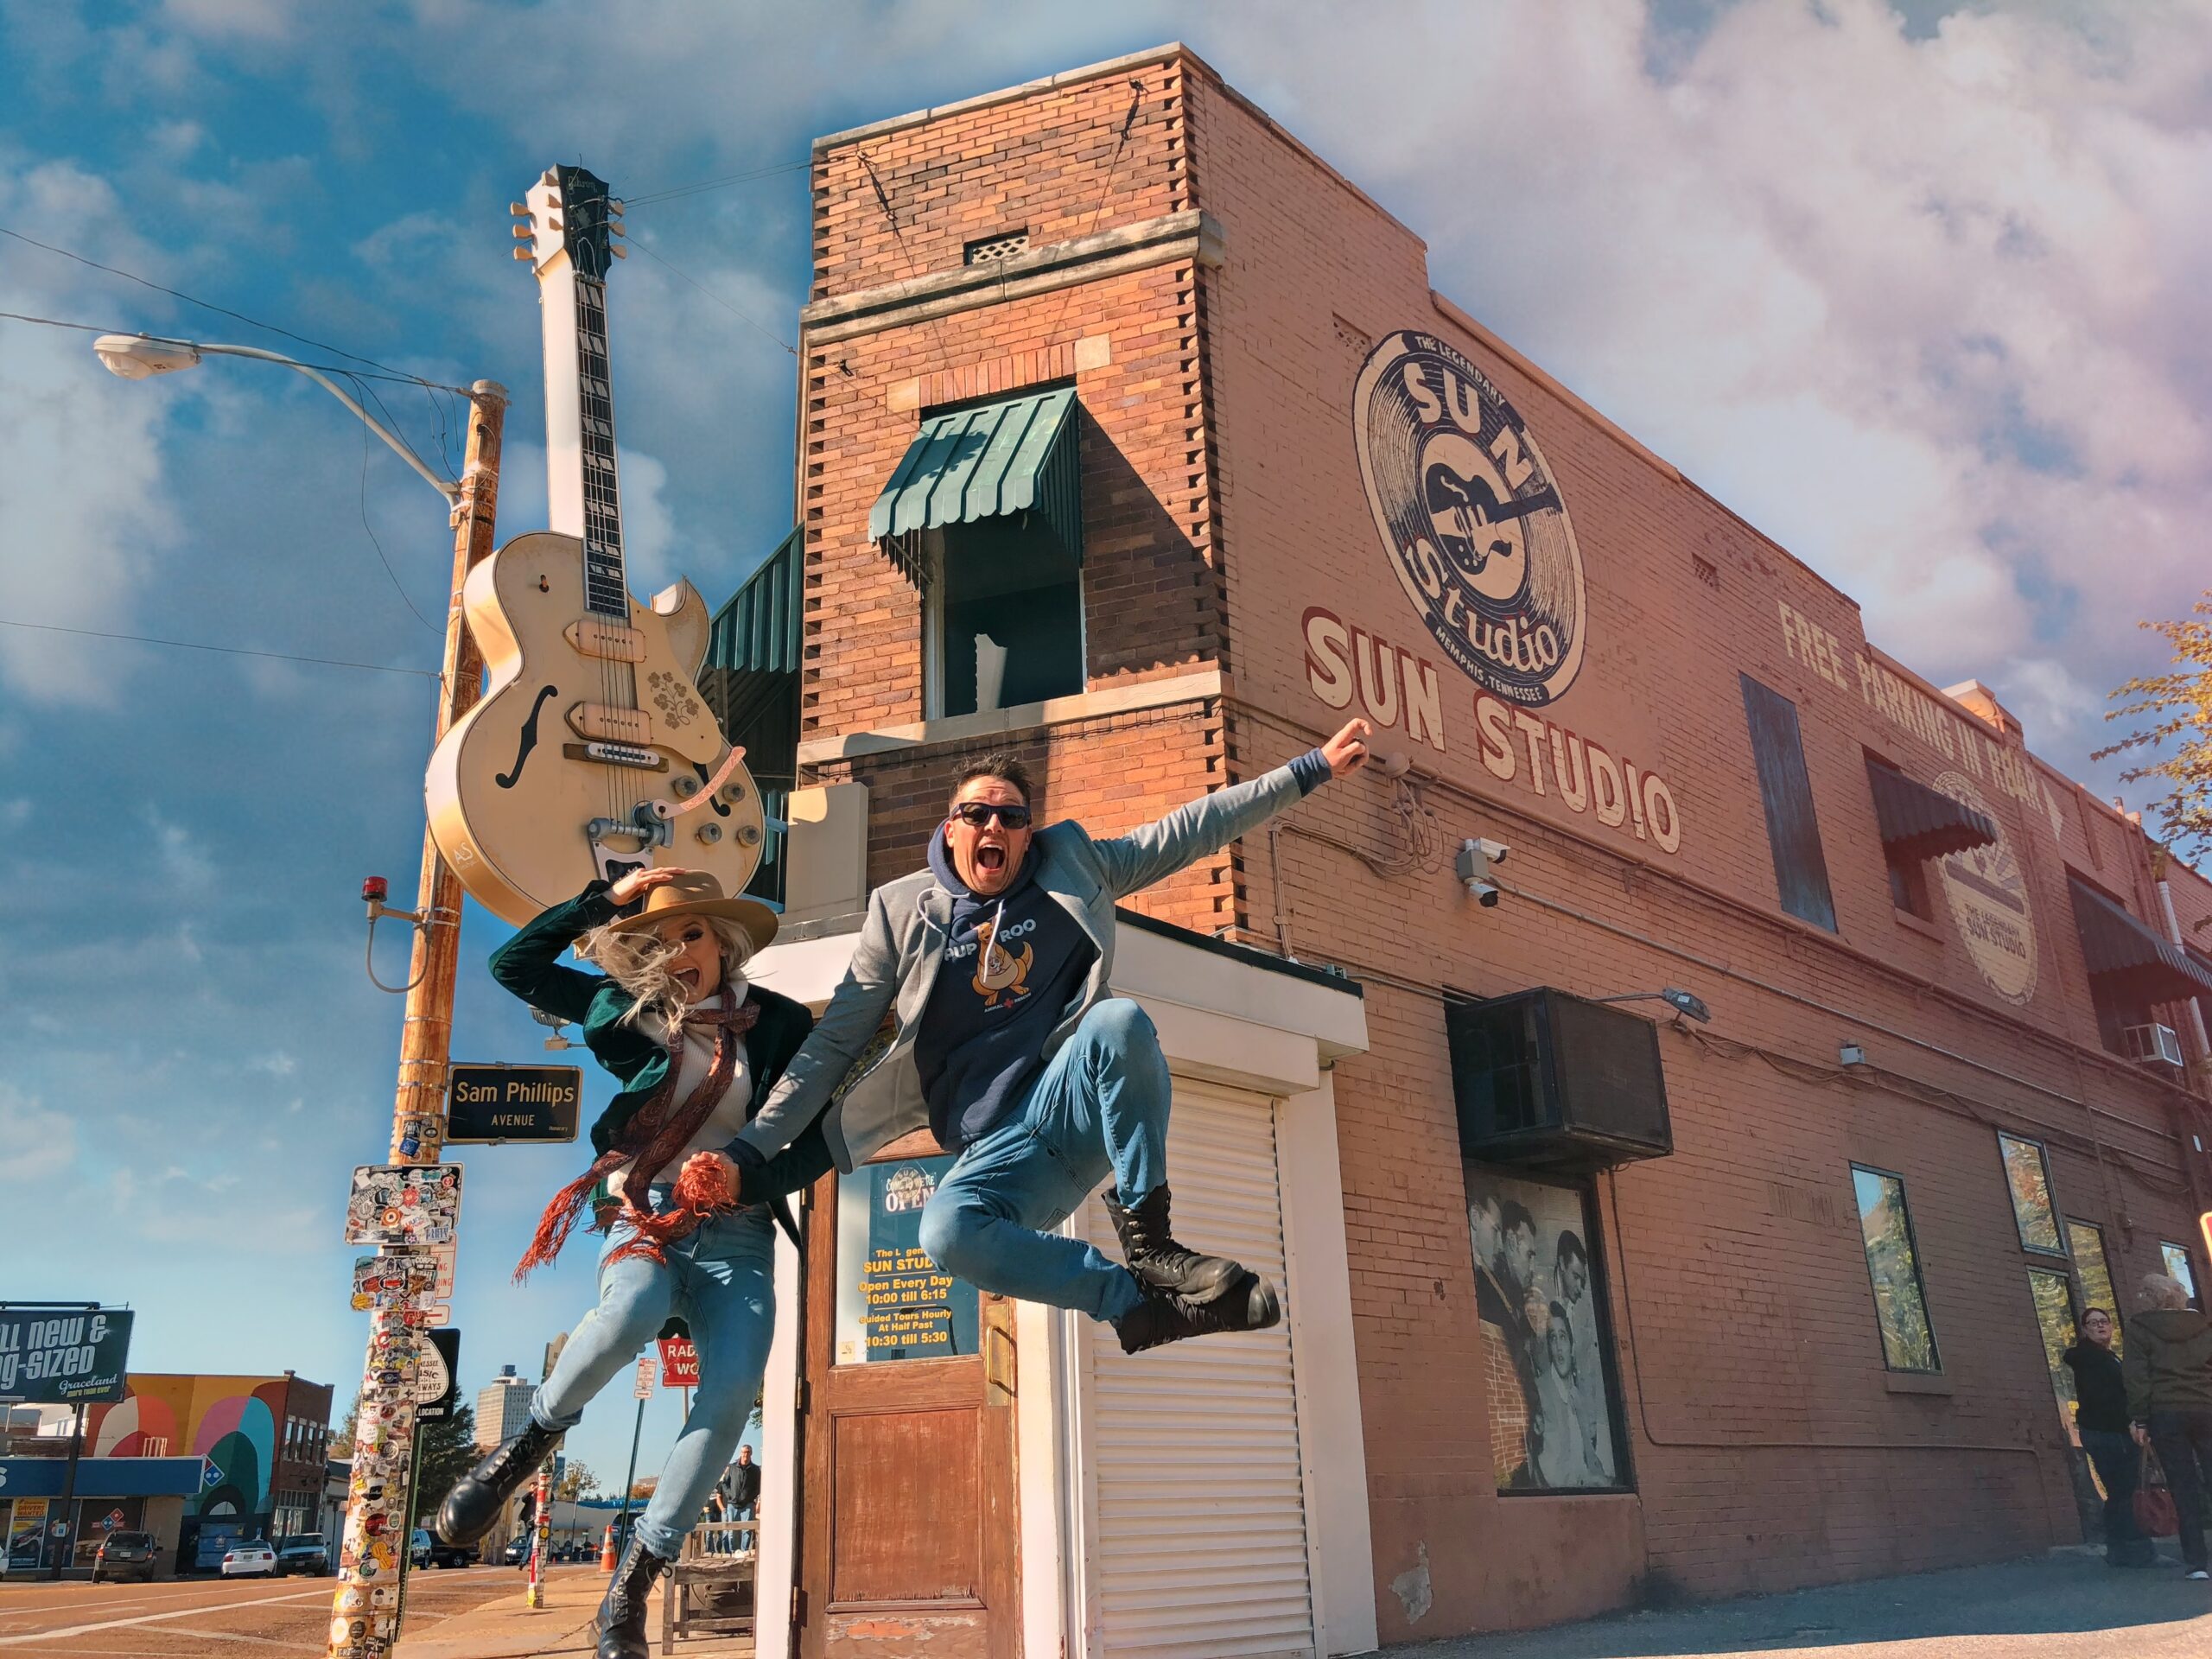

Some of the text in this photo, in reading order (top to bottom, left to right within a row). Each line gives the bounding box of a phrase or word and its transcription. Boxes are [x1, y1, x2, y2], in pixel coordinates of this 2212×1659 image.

[1414, 336, 1507, 407] THE LEGENDARY
[1403, 362, 1534, 490] SUN
[1404, 536, 1558, 672] Studio
[1488, 675, 1543, 702] TENNESSEE
[1777, 600, 1848, 690] FREE
[1853, 651, 1955, 761] PARKING
[1955, 718, 1984, 779] IN
[1302, 607, 1681, 854] SUN STUDIO
[1965, 903, 1980, 919] THE
[944, 918, 1037, 962] PUP ROO
[1966, 917, 2027, 960] SUN STUDIO
[984, 1003, 1004, 1013] ANIMAL
[455, 1081, 575, 1108] Sam Phillips
[491, 1114, 535, 1126] AVENUE
[876, 1249, 893, 1258] The
[864, 1256, 933, 1273] SUN STUD
[858, 1275, 953, 1293] Open Every Day
[866, 1288, 947, 1305] 10:00 till 6:15
[860, 1309, 951, 1325] Guided Tours Hourly
[89, 1314, 107, 1344] &
[878, 1320, 933, 1332] At Half Past
[865, 1331, 948, 1347] 10:30 till 5:30
[668, 1344, 699, 1357] RAD
[675, 1363, 700, 1376] WO
[59, 1374, 118, 1395] Graceland
[418, 1407, 444, 1416] LOCATION
